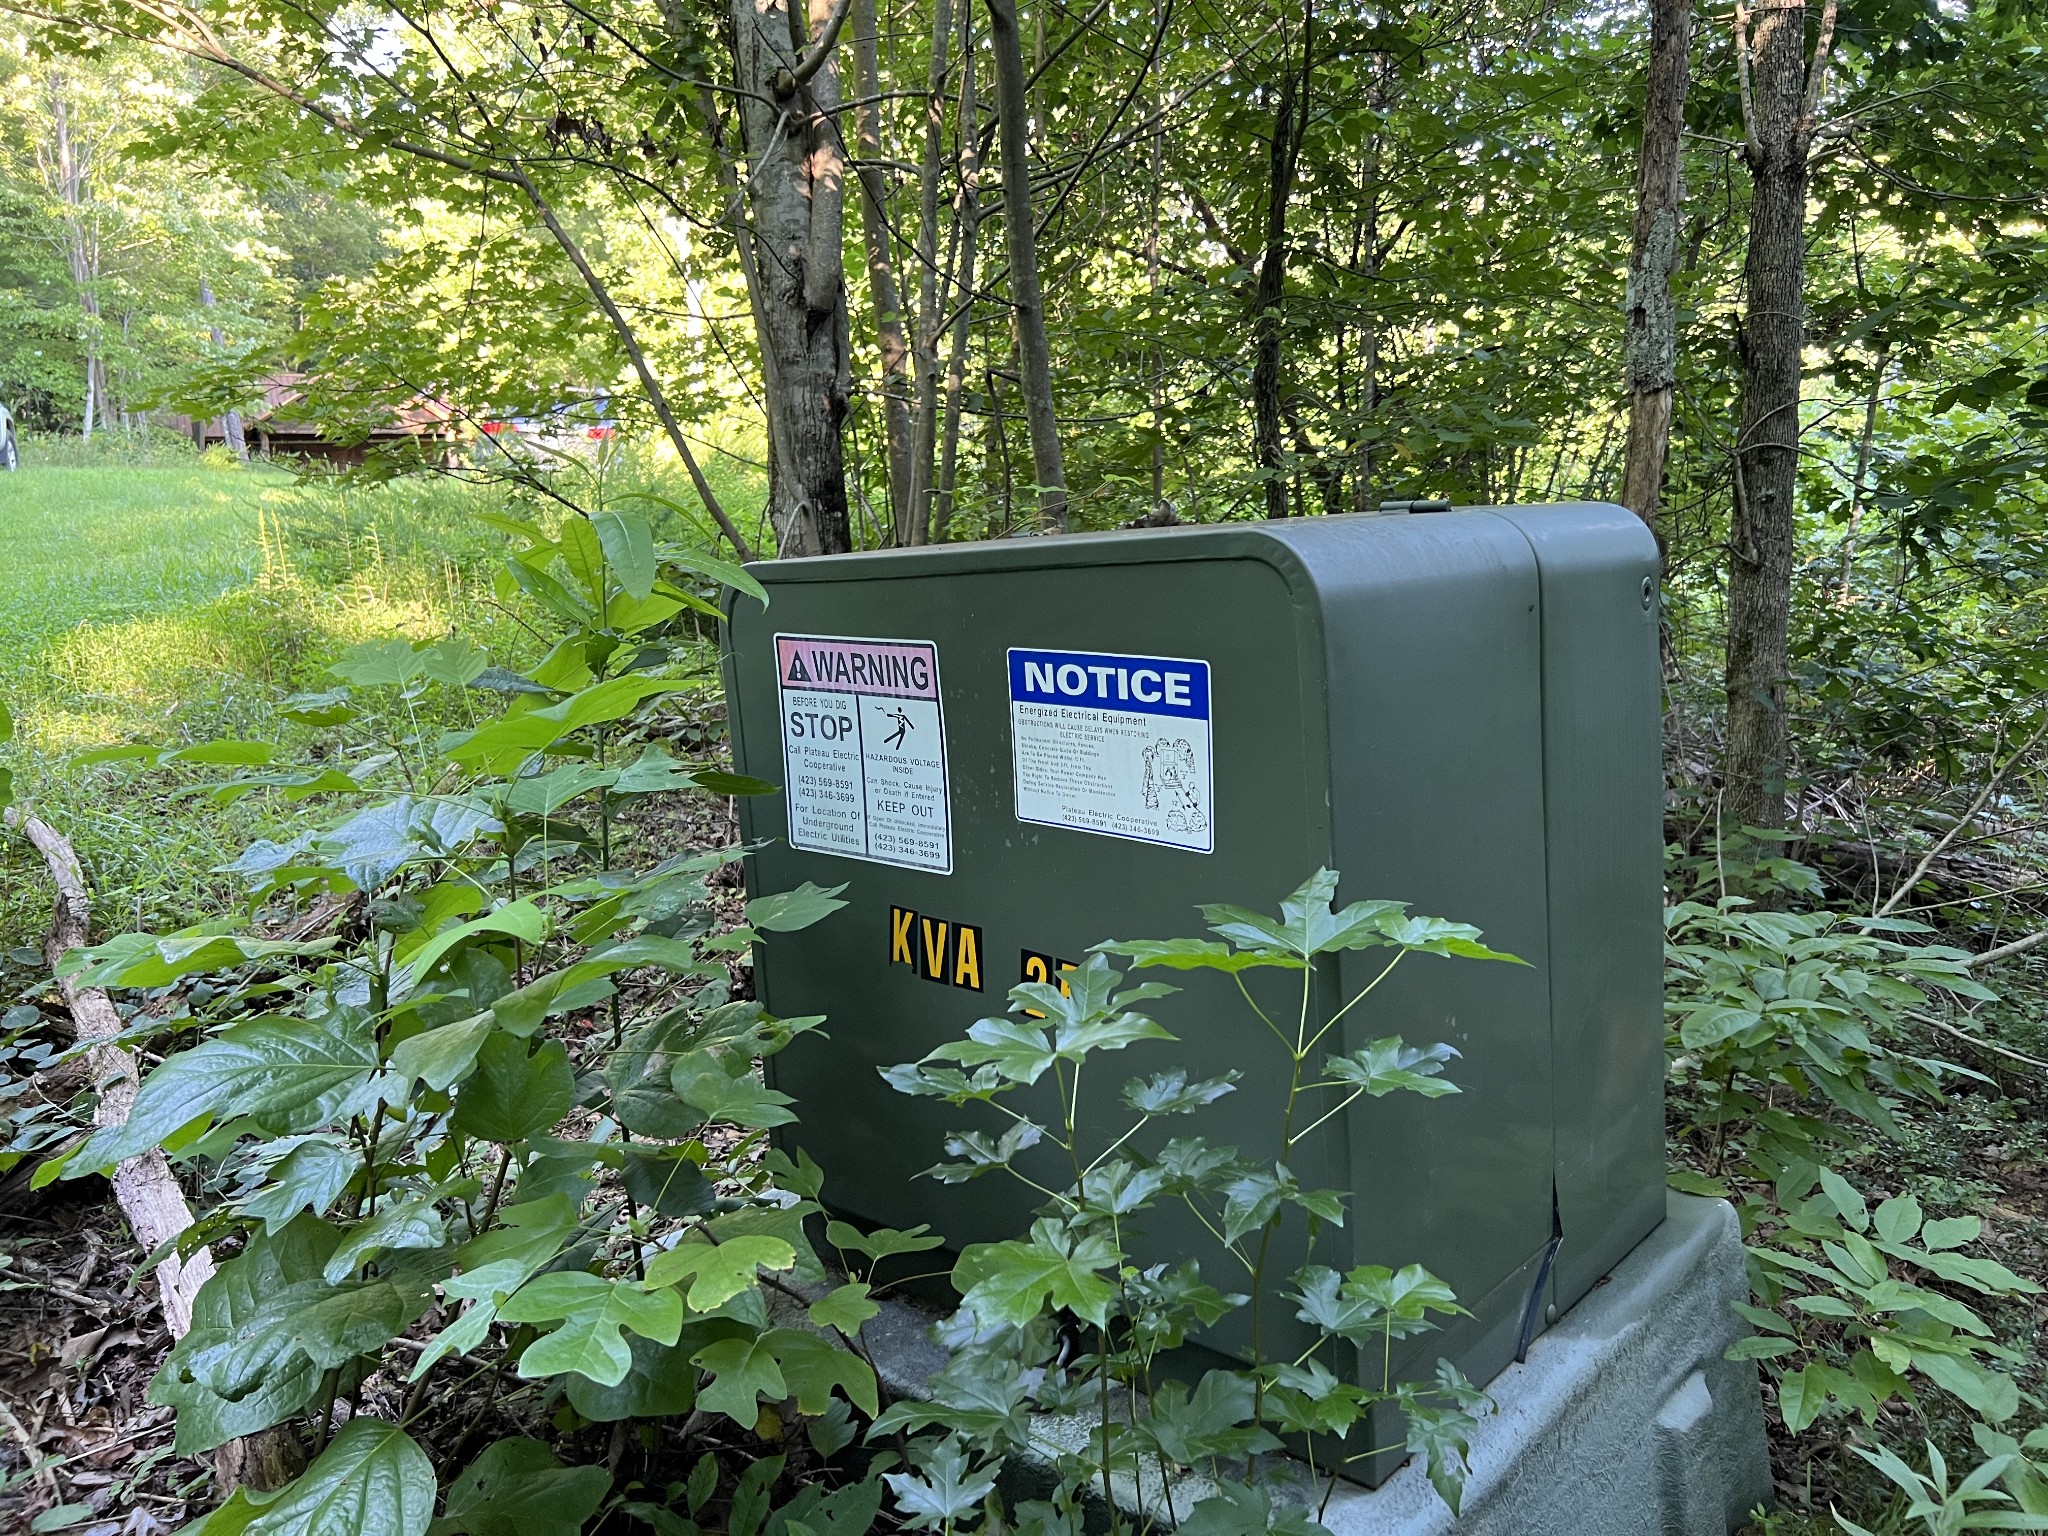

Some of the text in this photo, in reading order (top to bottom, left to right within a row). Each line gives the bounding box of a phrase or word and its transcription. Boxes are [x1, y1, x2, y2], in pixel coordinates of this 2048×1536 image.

[812, 650, 929, 691] WARNING
[1024, 662, 1192, 707] NOTICE
[793, 697, 847, 710] BEFORE YOU DIG
[1019, 704, 1147, 727] Energized Electrical Equipment
[791, 712, 853, 741] STOP
[1018, 718, 1053, 728] OBSTRUCTIONS
[1067, 723, 1083, 732] CAUSE
[1084, 725, 1103, 734] DELAYS
[1104, 728, 1119, 736] WHEN
[1120, 729, 1150, 739] RESTORING
[1059, 732, 1105, 743] ELECTRIC SERVICE
[789, 745, 860, 761] Call Plateau Electric
[866, 753, 941, 768] HAZARDOUS VOLTAGE
[804, 759, 846, 772] Cooperative
[893, 766, 914, 775] INSIDE
[798, 775, 854, 790] (423) 569-8591
[904, 782, 923, 790] Cause
[926, 784, 943, 794] Injury
[799, 787, 855, 803] (423) 346-3699
[884, 788, 902, 796] Death
[912, 792, 935, 801] Entered
[795, 803, 861, 820] For Location Of
[877, 800, 934, 818] KEEP OUT
[1062, 805, 1158, 826] Plateau Electric Cooperative
[803, 817, 854, 832] Underground
[1062, 814, 1160, 836] (423) 569-8591 (423) 346-3699
[798, 828, 860, 846] Electric Utilities
[874, 833, 939, 850] (423) 569-8591
[874, 842, 940, 859] (423) 346-3699
[893, 908, 980, 989] KVA
